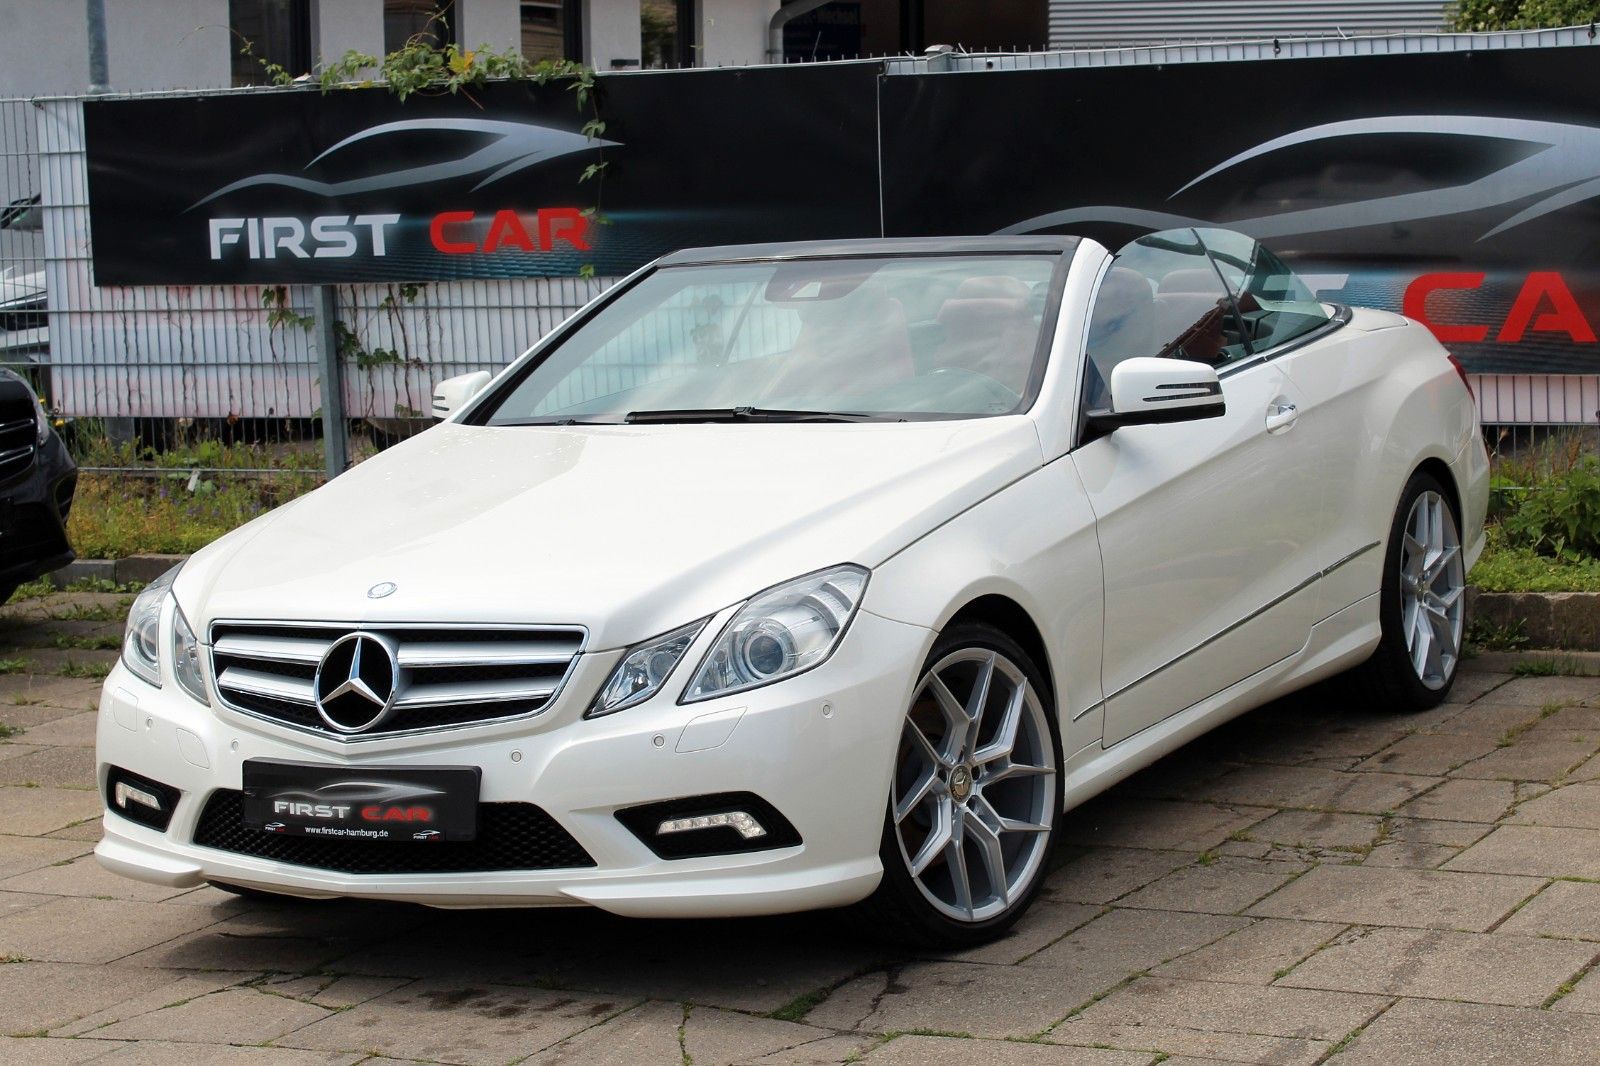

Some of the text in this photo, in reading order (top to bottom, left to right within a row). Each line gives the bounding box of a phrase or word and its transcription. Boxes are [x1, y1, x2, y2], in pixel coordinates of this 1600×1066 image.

[208, 207, 592, 260] FIRST CAR
[274, 801, 431, 822] FIRST CAR
[305, 826, 388, 838] www.firstcar-hamburg.de
